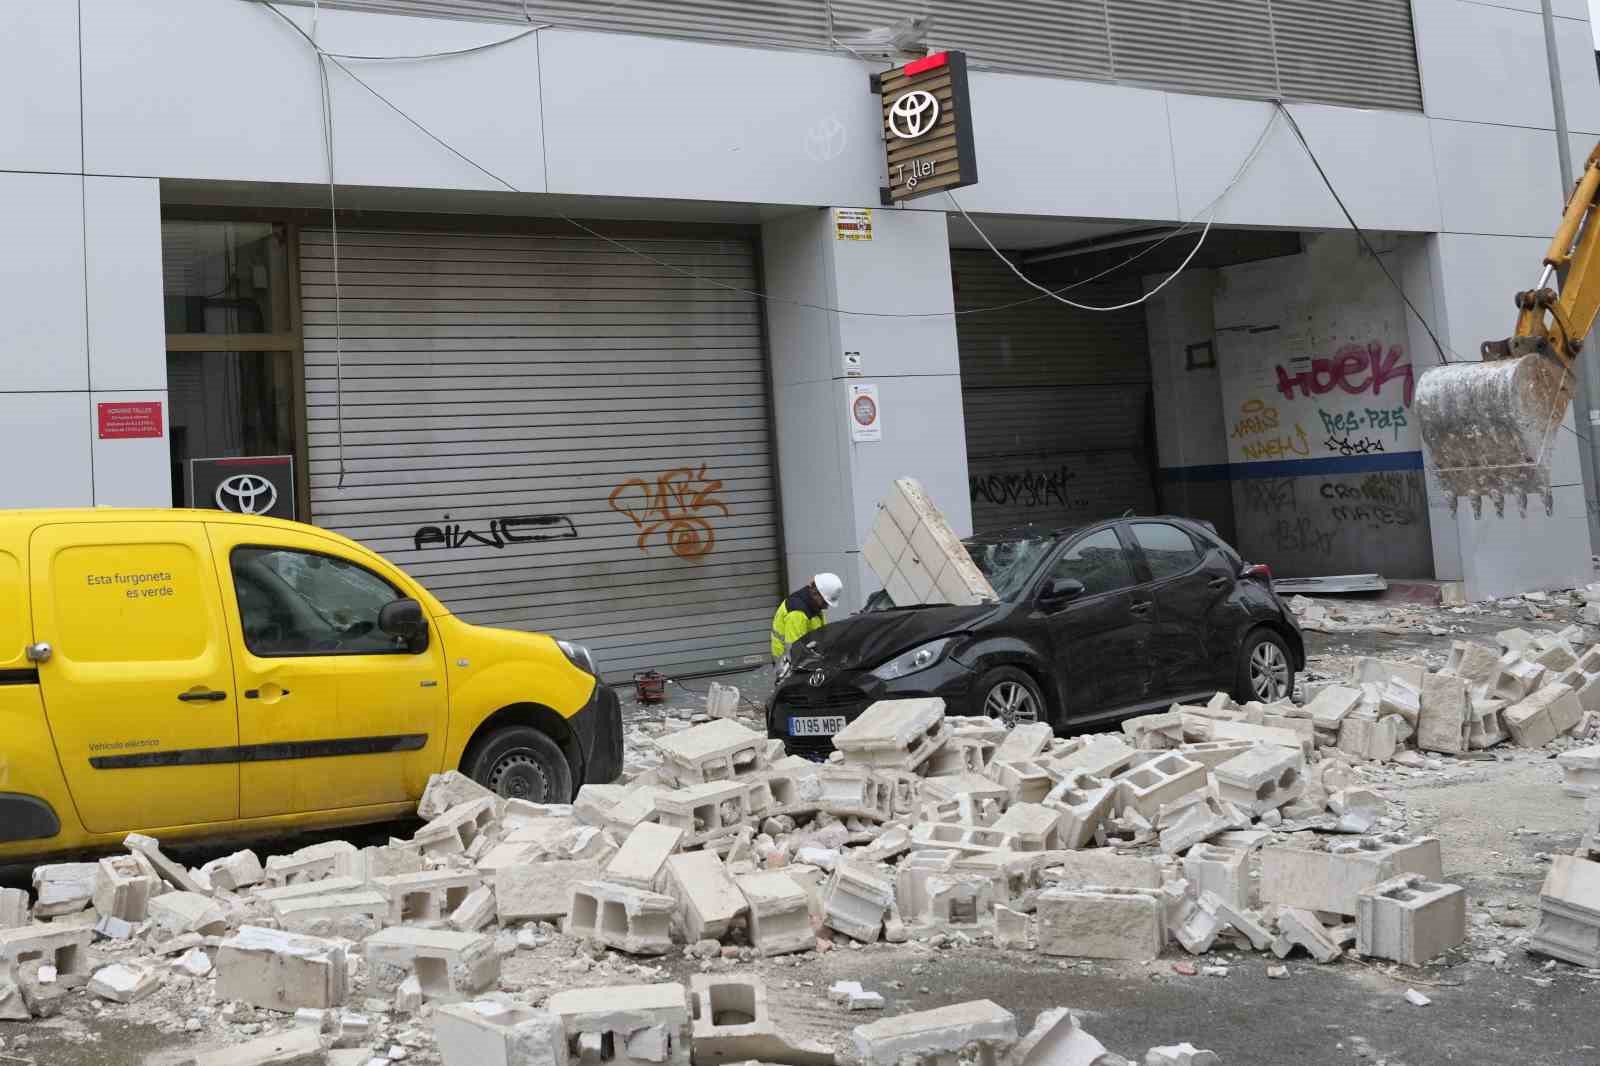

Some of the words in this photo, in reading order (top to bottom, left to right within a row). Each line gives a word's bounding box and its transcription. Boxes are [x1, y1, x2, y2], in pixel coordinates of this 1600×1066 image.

[87, 574, 112, 586] Esta
[115, 572, 172, 585] furgoneta
[126, 588, 139, 599] es
[141, 586, 174, 597] verde
[795, 720, 819, 733] 0195
